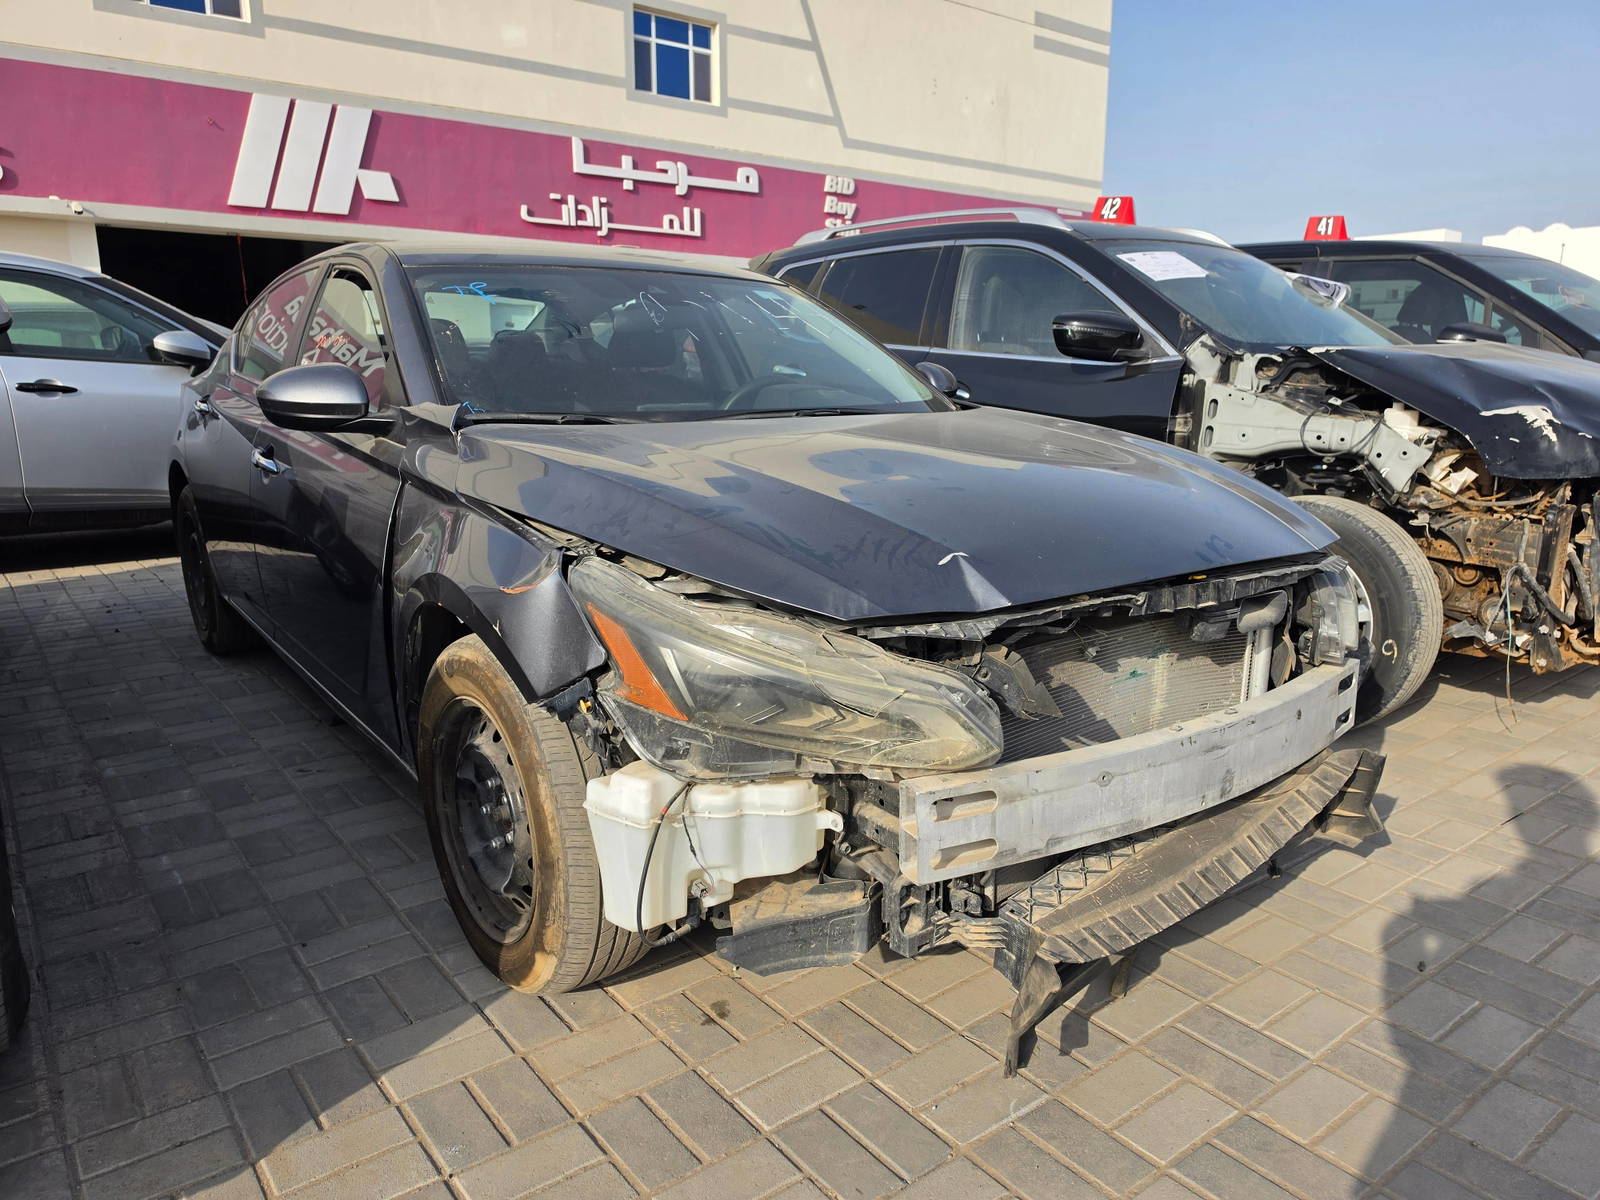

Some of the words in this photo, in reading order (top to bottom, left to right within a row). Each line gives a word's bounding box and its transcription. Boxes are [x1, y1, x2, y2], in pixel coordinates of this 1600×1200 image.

[571, 136, 759, 195] مرحبا
[520, 193, 702, 236] للمزادات
[1101, 197, 1121, 219] 42
[1317, 216, 1334, 236] 41
